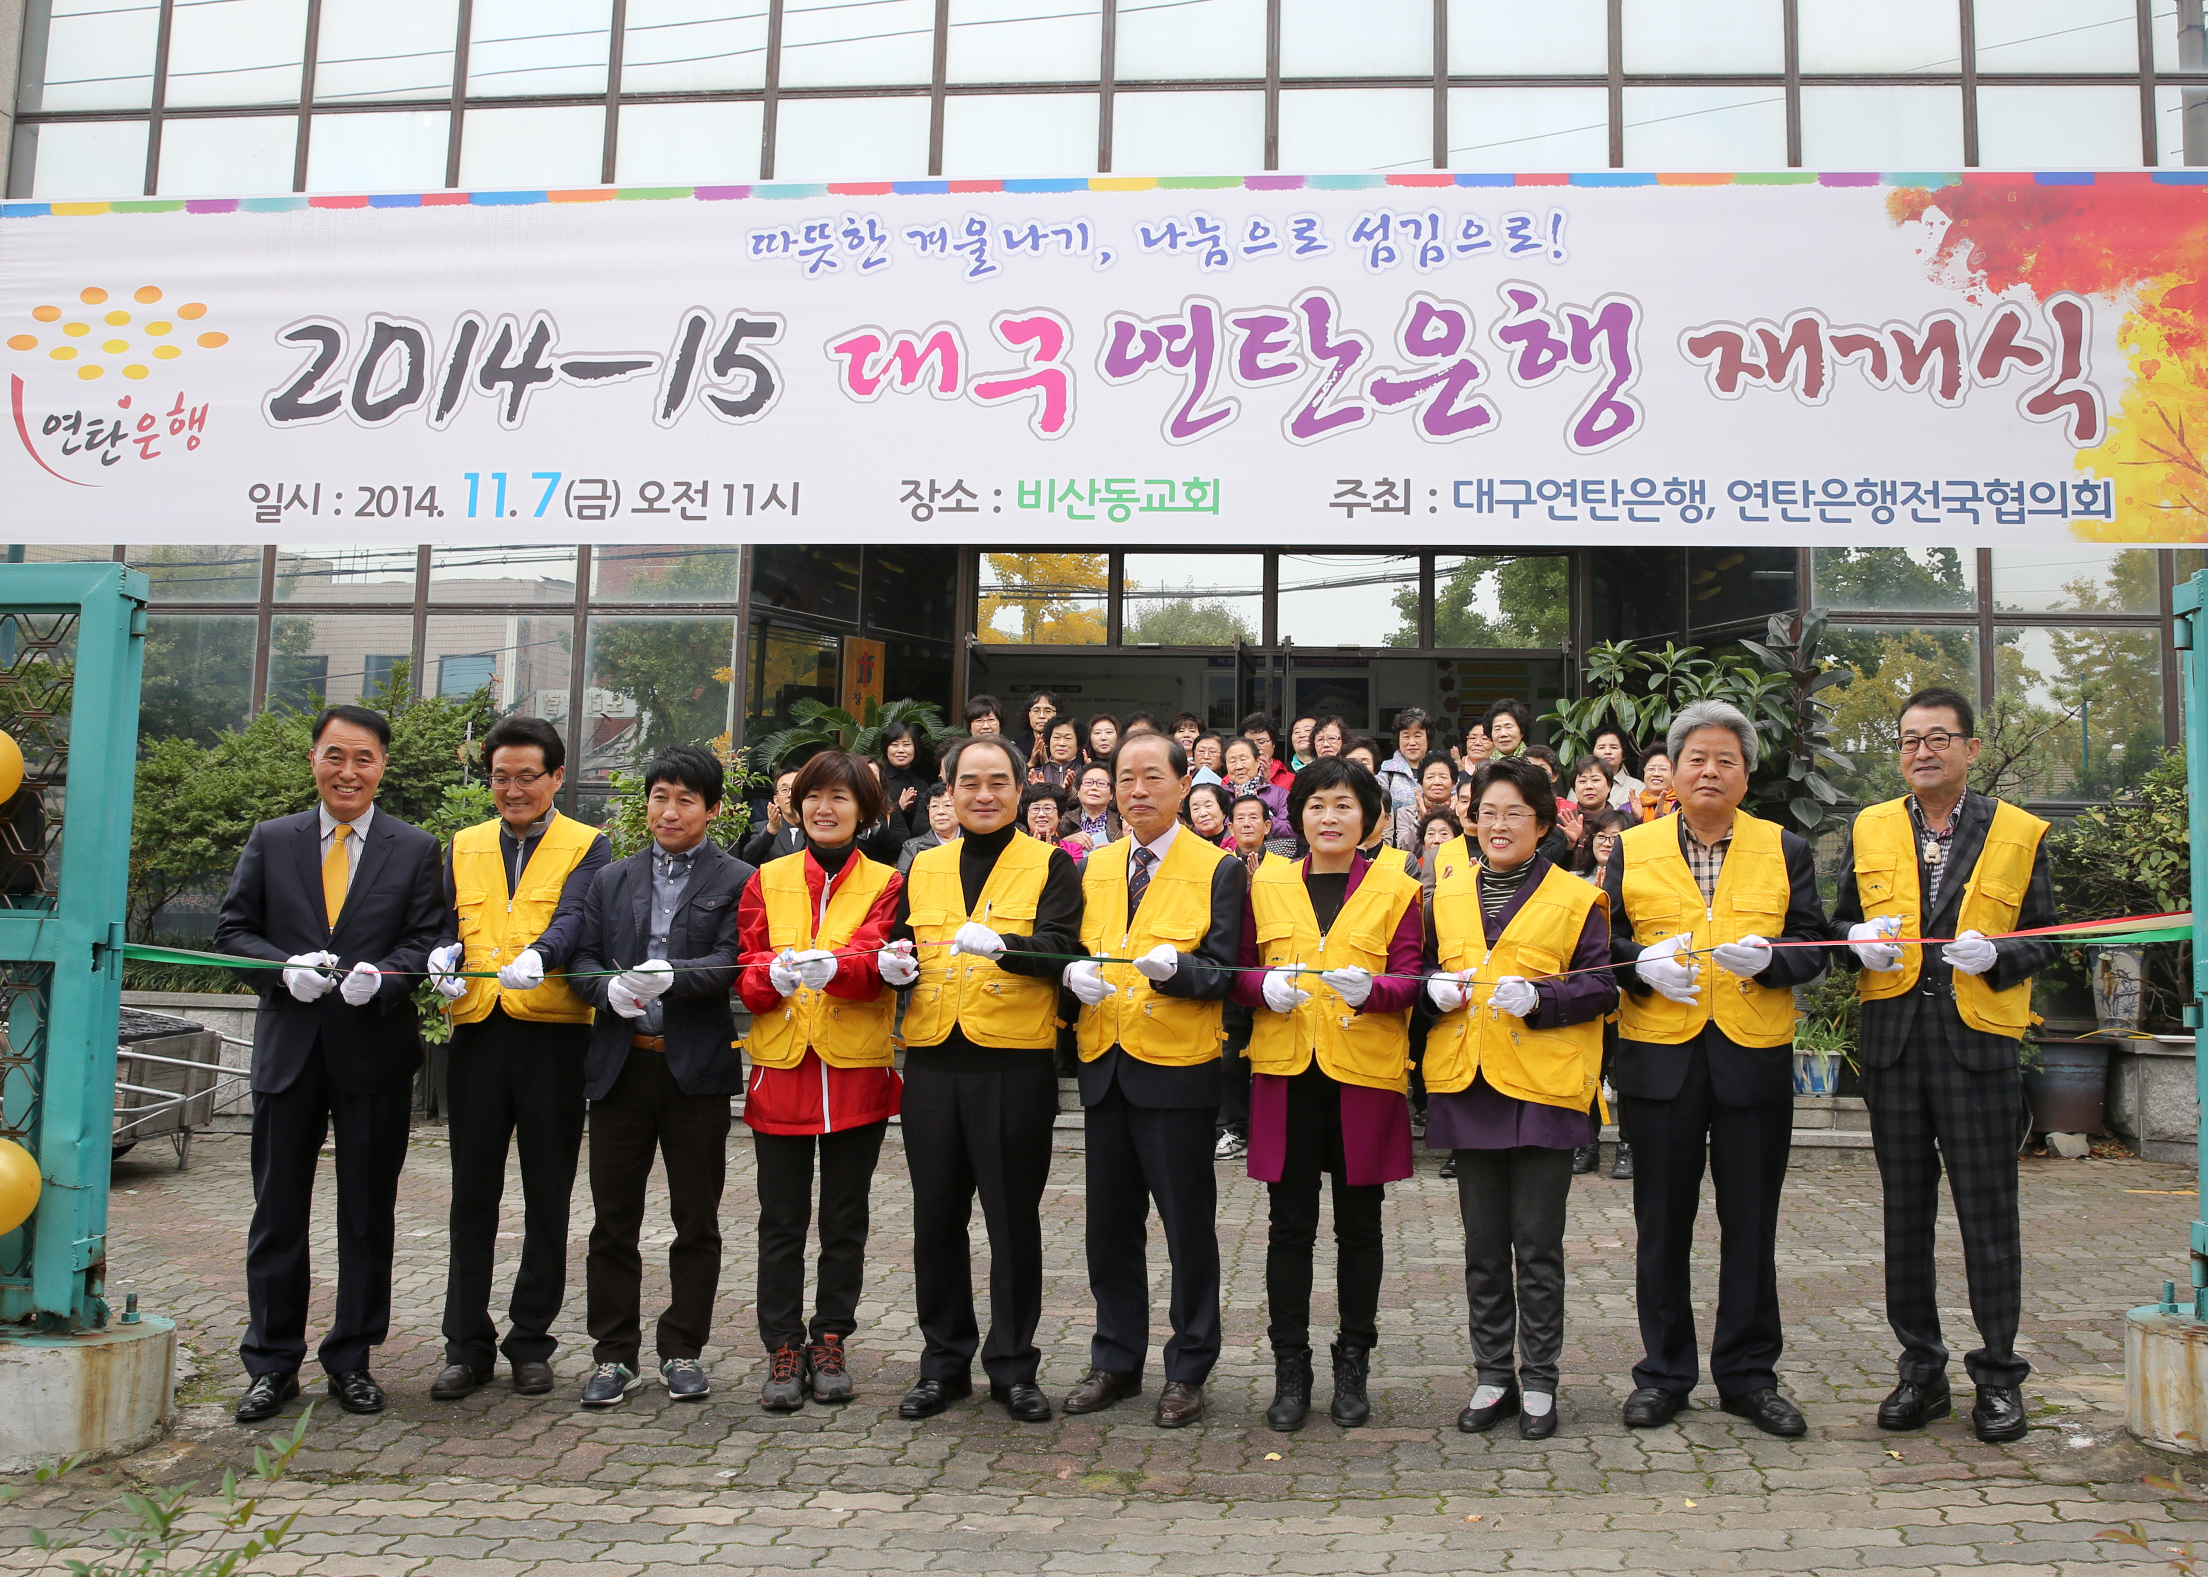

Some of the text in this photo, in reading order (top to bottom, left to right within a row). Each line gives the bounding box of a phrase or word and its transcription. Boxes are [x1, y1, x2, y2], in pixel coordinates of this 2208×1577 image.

[752, 213, 1563, 277] 따뜻한 겨울나기, 나눔으로 섬김으로!
[833, 316, 1067, 433] 대구
[1104, 288, 1635, 448] 연탄은행
[1687, 299, 2100, 443] 재개식
[42, 391, 209, 467] 연탄은행
[248, 482, 321, 523] 일시
[354, 485, 444, 518] 2014.
[631, 480, 709, 521] 오전
[723, 482, 801, 516] 11시
[899, 479, 979, 522] 장소
[1018, 476, 1221, 523] 비산동교회
[1329, 477, 1411, 519] 주최
[1453, 476, 1716, 524] 대구연탄은행,
[1727, 477, 2114, 525] 연탄은행전국협의회
